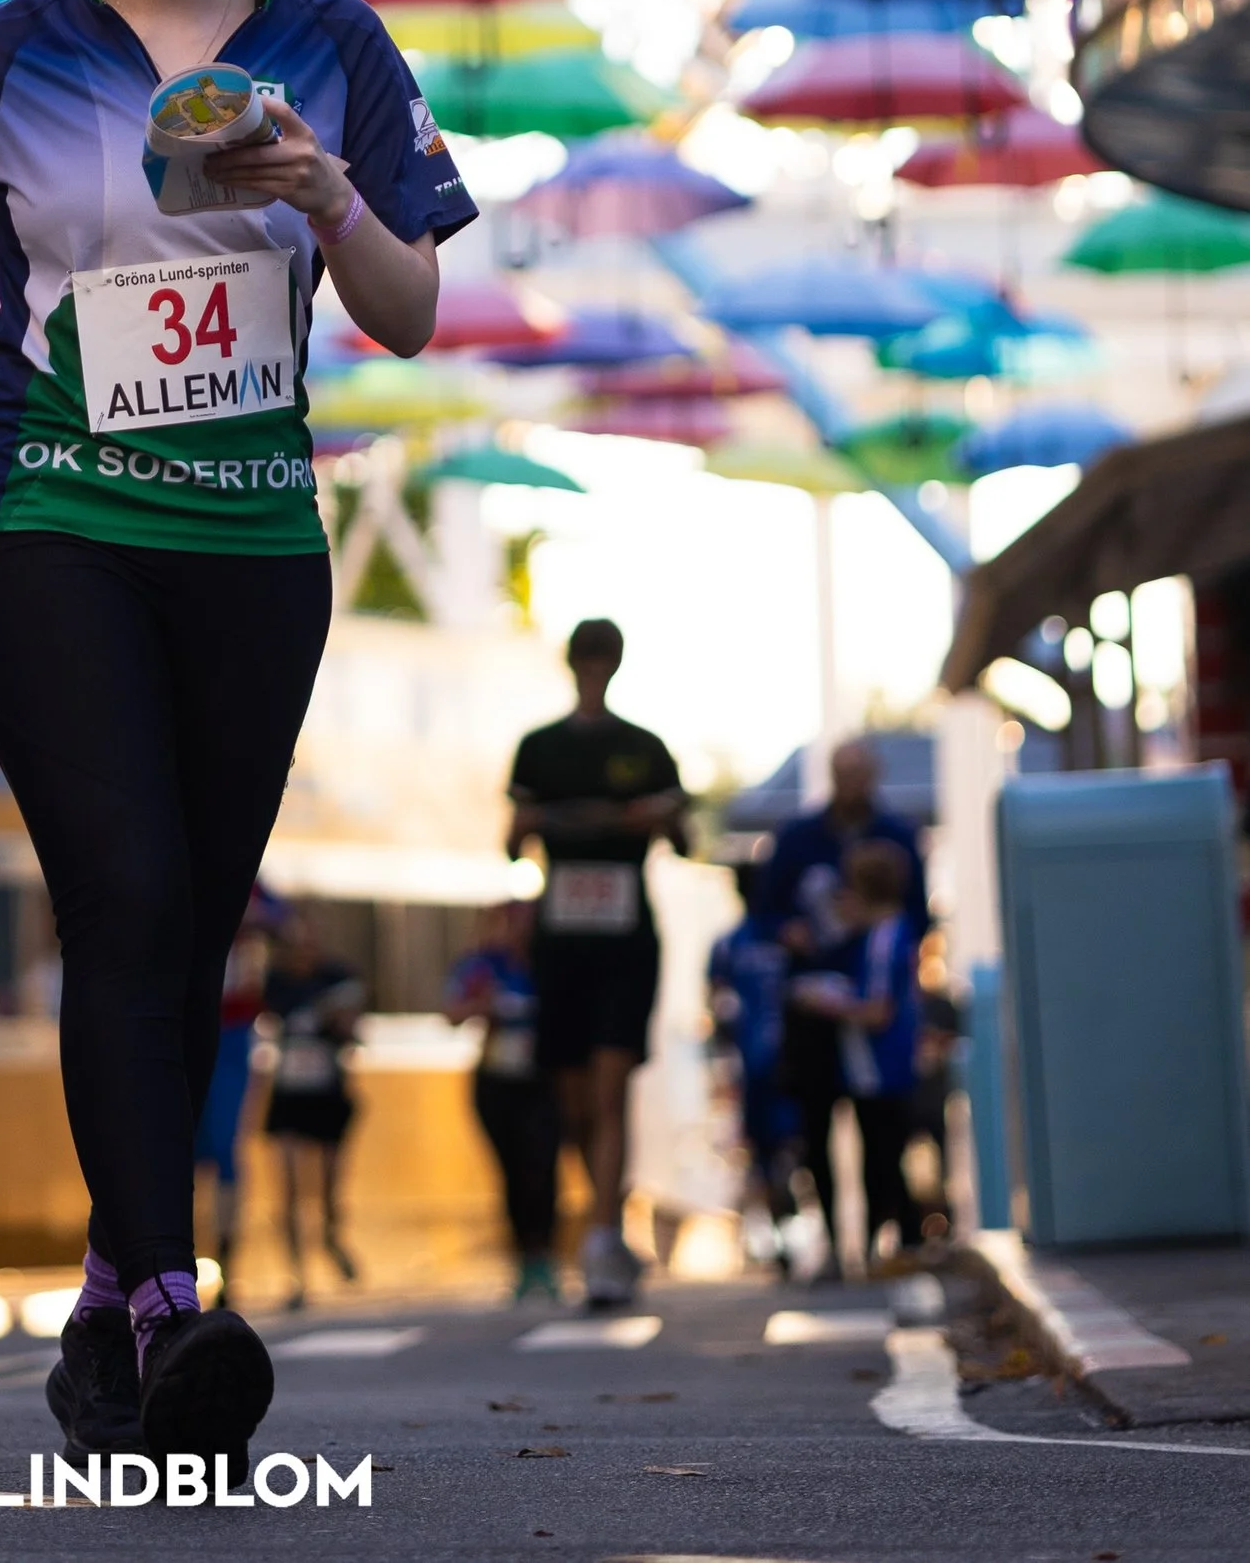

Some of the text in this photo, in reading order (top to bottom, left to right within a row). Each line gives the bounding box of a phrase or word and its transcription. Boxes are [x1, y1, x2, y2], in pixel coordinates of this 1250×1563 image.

[114, 261, 250, 288] Gröna Lund-sprinten
[147, 281, 238, 366] 34
[18, 441, 83, 472] OK
